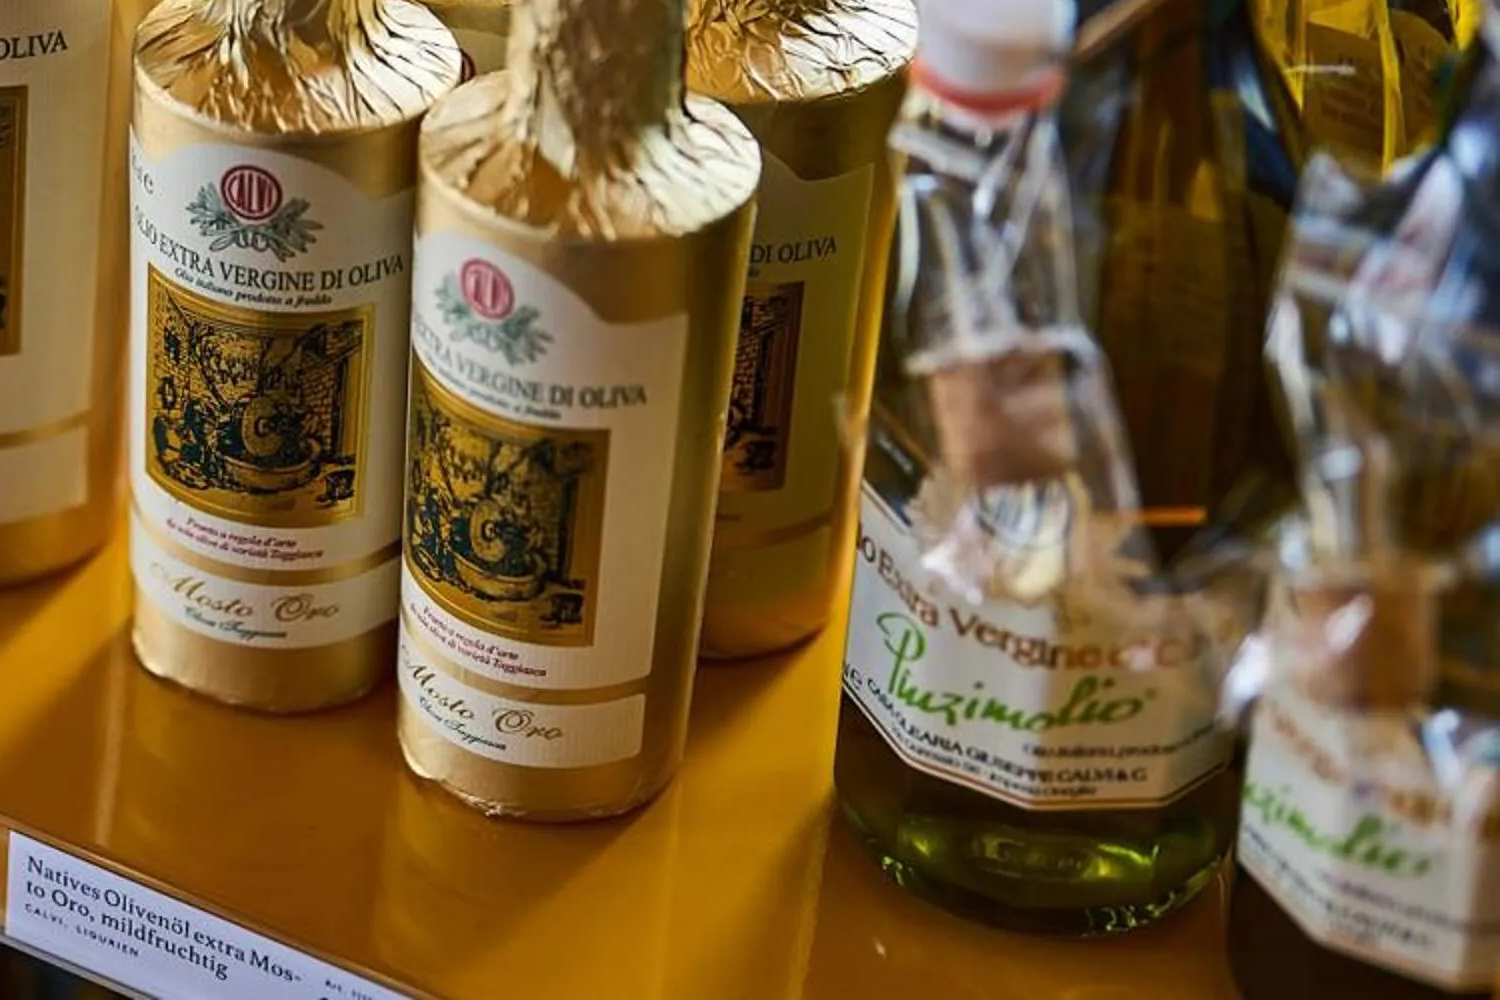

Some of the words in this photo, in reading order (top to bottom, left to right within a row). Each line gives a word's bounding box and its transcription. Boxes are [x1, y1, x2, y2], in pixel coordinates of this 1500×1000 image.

[159, 233, 215, 277] EXTRA
[220, 261, 314, 291] VERGINE
[321, 270, 343, 291] DI
[349, 253, 404, 285] OLIVA
[750, 244, 773, 264] DI
[778, 235, 837, 265] OLIVA
[457, 353, 545, 403] VERGINE
[550, 384, 574, 408] DI
[579, 384, 648, 409] OLIVA
[150, 562, 254, 618] Mosto
[269, 591, 341, 625] Oro
[946, 606, 1102, 671] Vergine
[401, 645, 476, 720] Mosto
[491, 705, 565, 741] Oro
[26, 881, 45, 899] to
[51, 889, 96, 923] Oro,
[100, 912, 228, 981] mildfruchtig
[27, 855, 101, 901] Natives
[103, 889, 190, 939] Olivenöl
[193, 930, 246, 963] extra
[249, 949, 302, 982] Mos-
[75, 924, 139, 957] LIGURIEN
